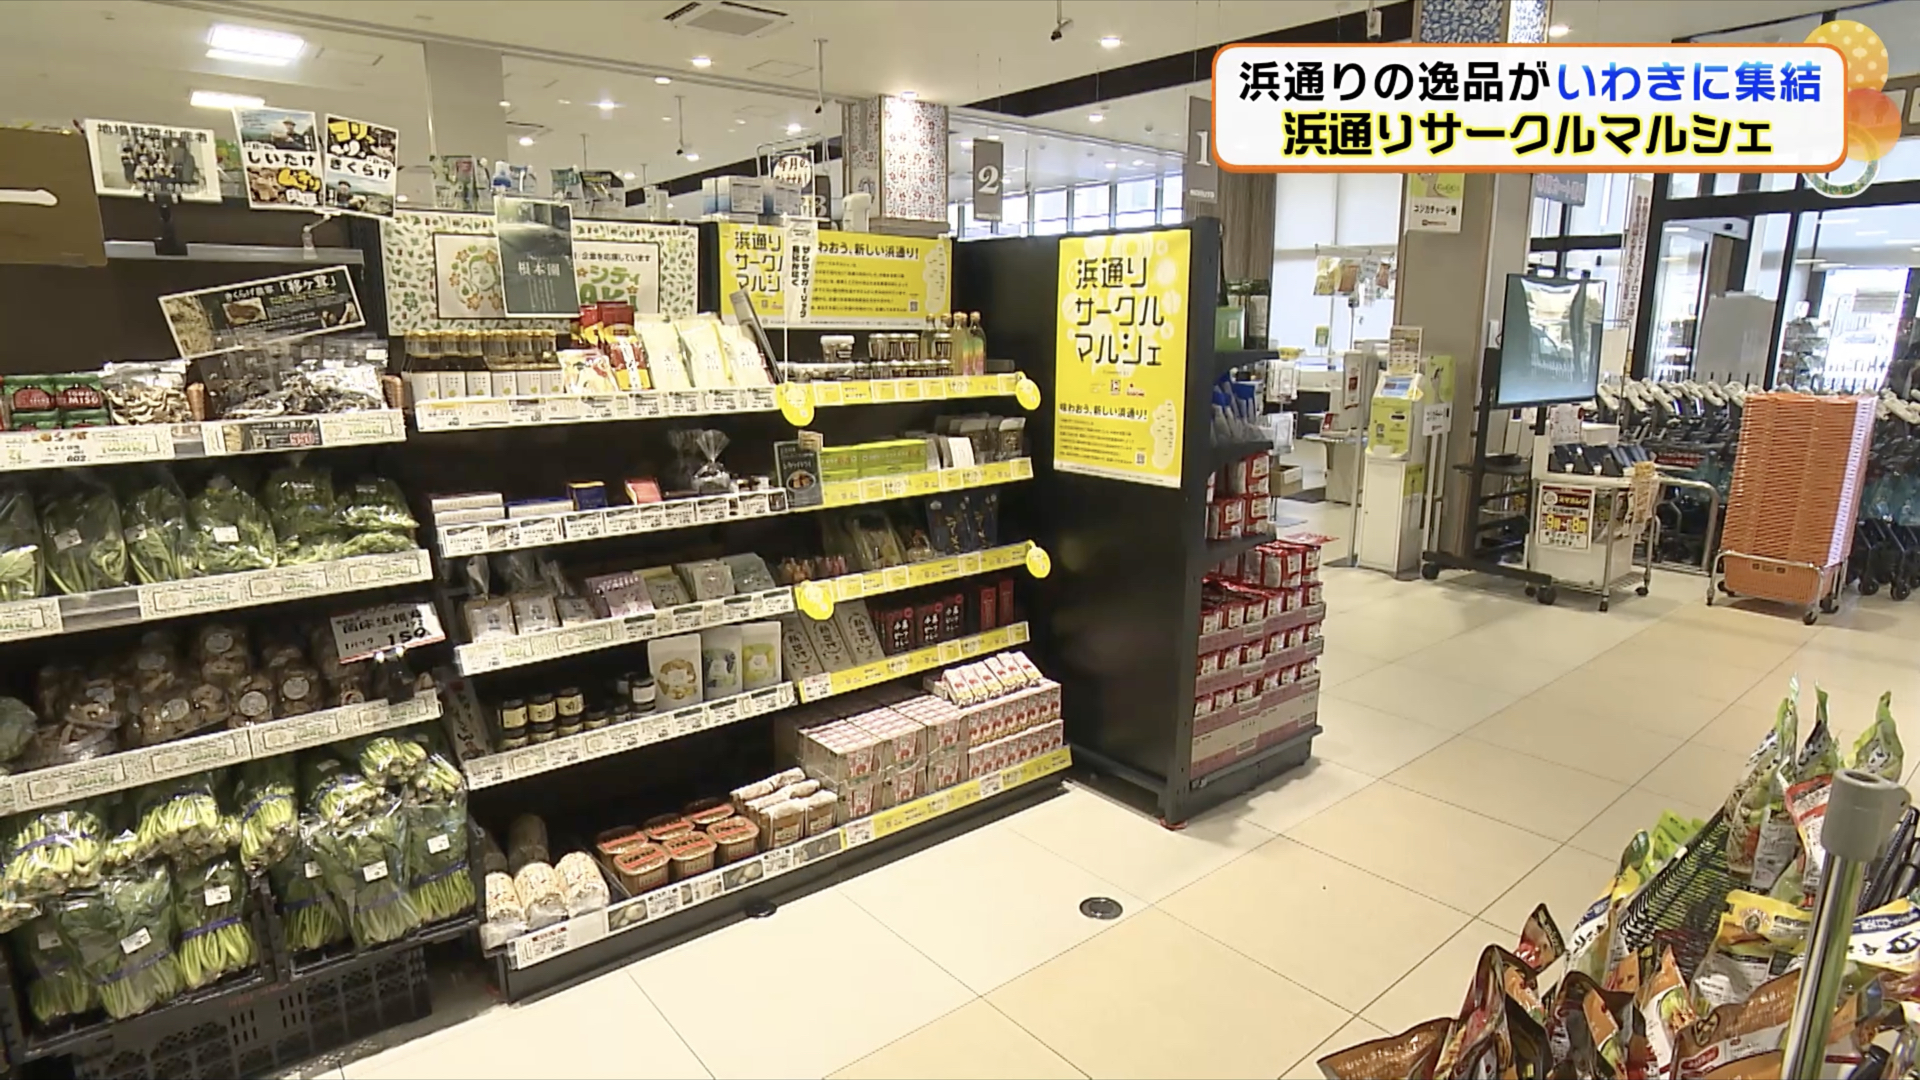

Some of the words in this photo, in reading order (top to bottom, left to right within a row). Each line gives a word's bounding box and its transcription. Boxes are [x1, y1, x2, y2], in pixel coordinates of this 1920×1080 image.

[247, 151, 315, 168] しいたけ
[1196, 130, 1211, 167] 1
[330, 159, 391, 180] きくらげ
[977, 165, 999, 195] 2
[735, 231, 781, 251] 浜通り
[1076, 257, 1147, 290] 浜通り
[1075, 296, 1164, 326] サークル
[1075, 334, 1162, 366] マルシェ
